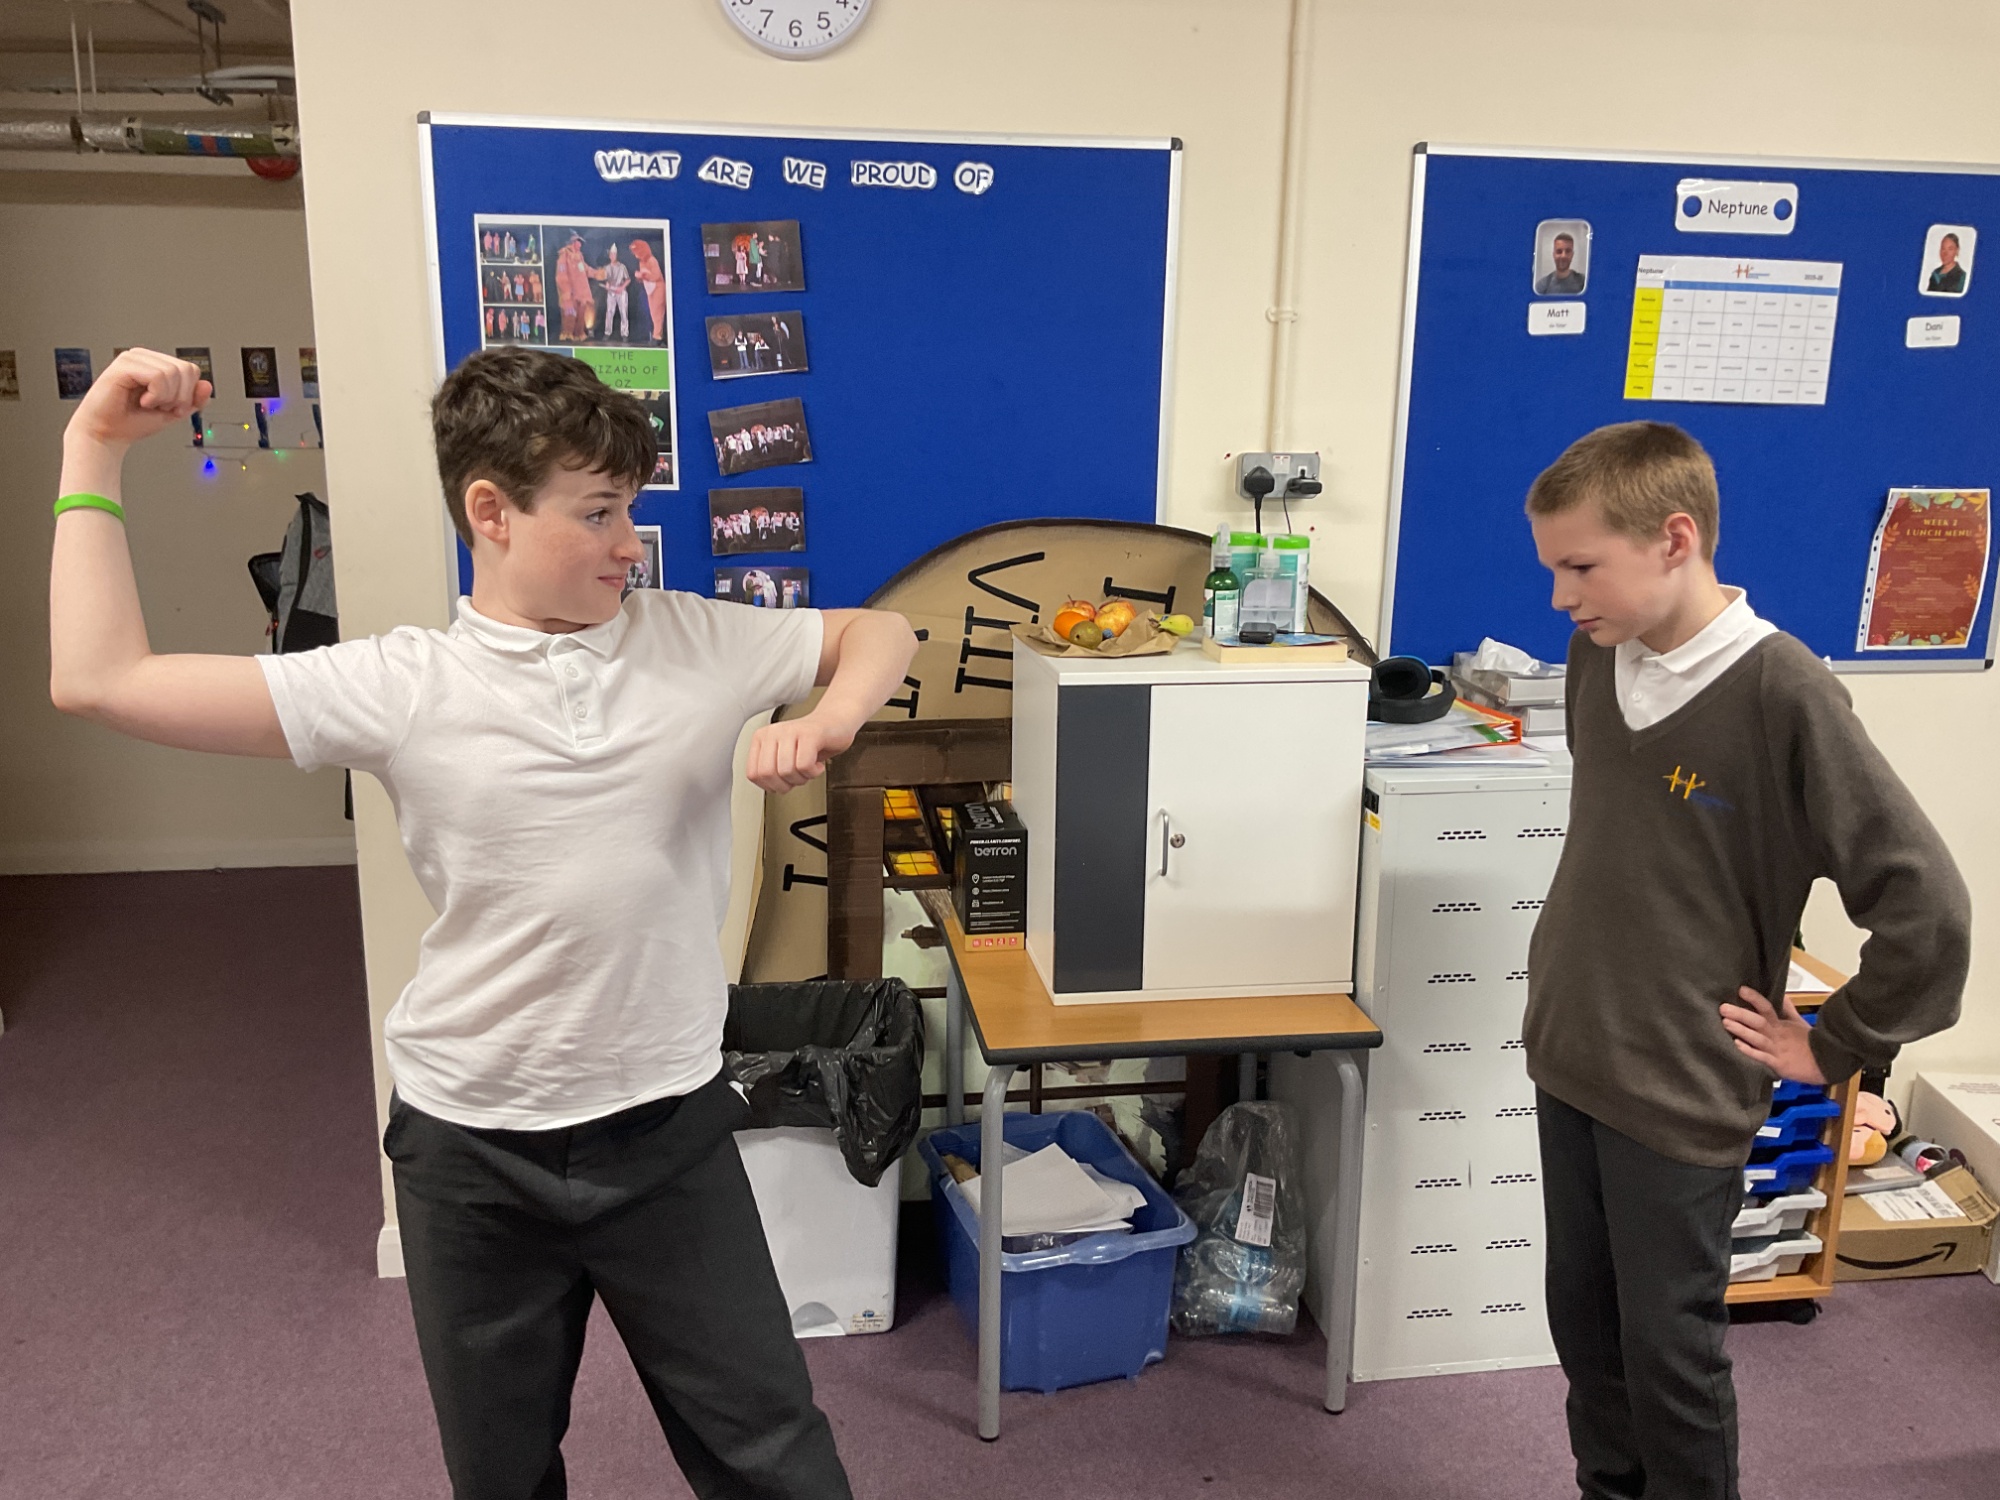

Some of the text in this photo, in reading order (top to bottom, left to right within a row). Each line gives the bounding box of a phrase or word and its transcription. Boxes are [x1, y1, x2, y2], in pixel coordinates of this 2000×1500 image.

[760, 9, 774, 28] 7
[817, 12, 831, 30] 5
[788, 19, 803, 38] 6
[602, 155, 990, 189] WHAT ARE WE PROUD OF
[1707, 199, 1768, 219] Neptune
[1547, 308, 1569, 318] Matt
[1925, 321, 1944, 331] Dani
[610, 351, 634, 360] THE
[643, 365, 659, 375] OF
[614, 379, 632, 388] OZ
[1923, 518, 1949, 527] WEEK
[1906, 528, 1973, 537] LUNCH MENU
[974, 846, 1017, 857] betron
